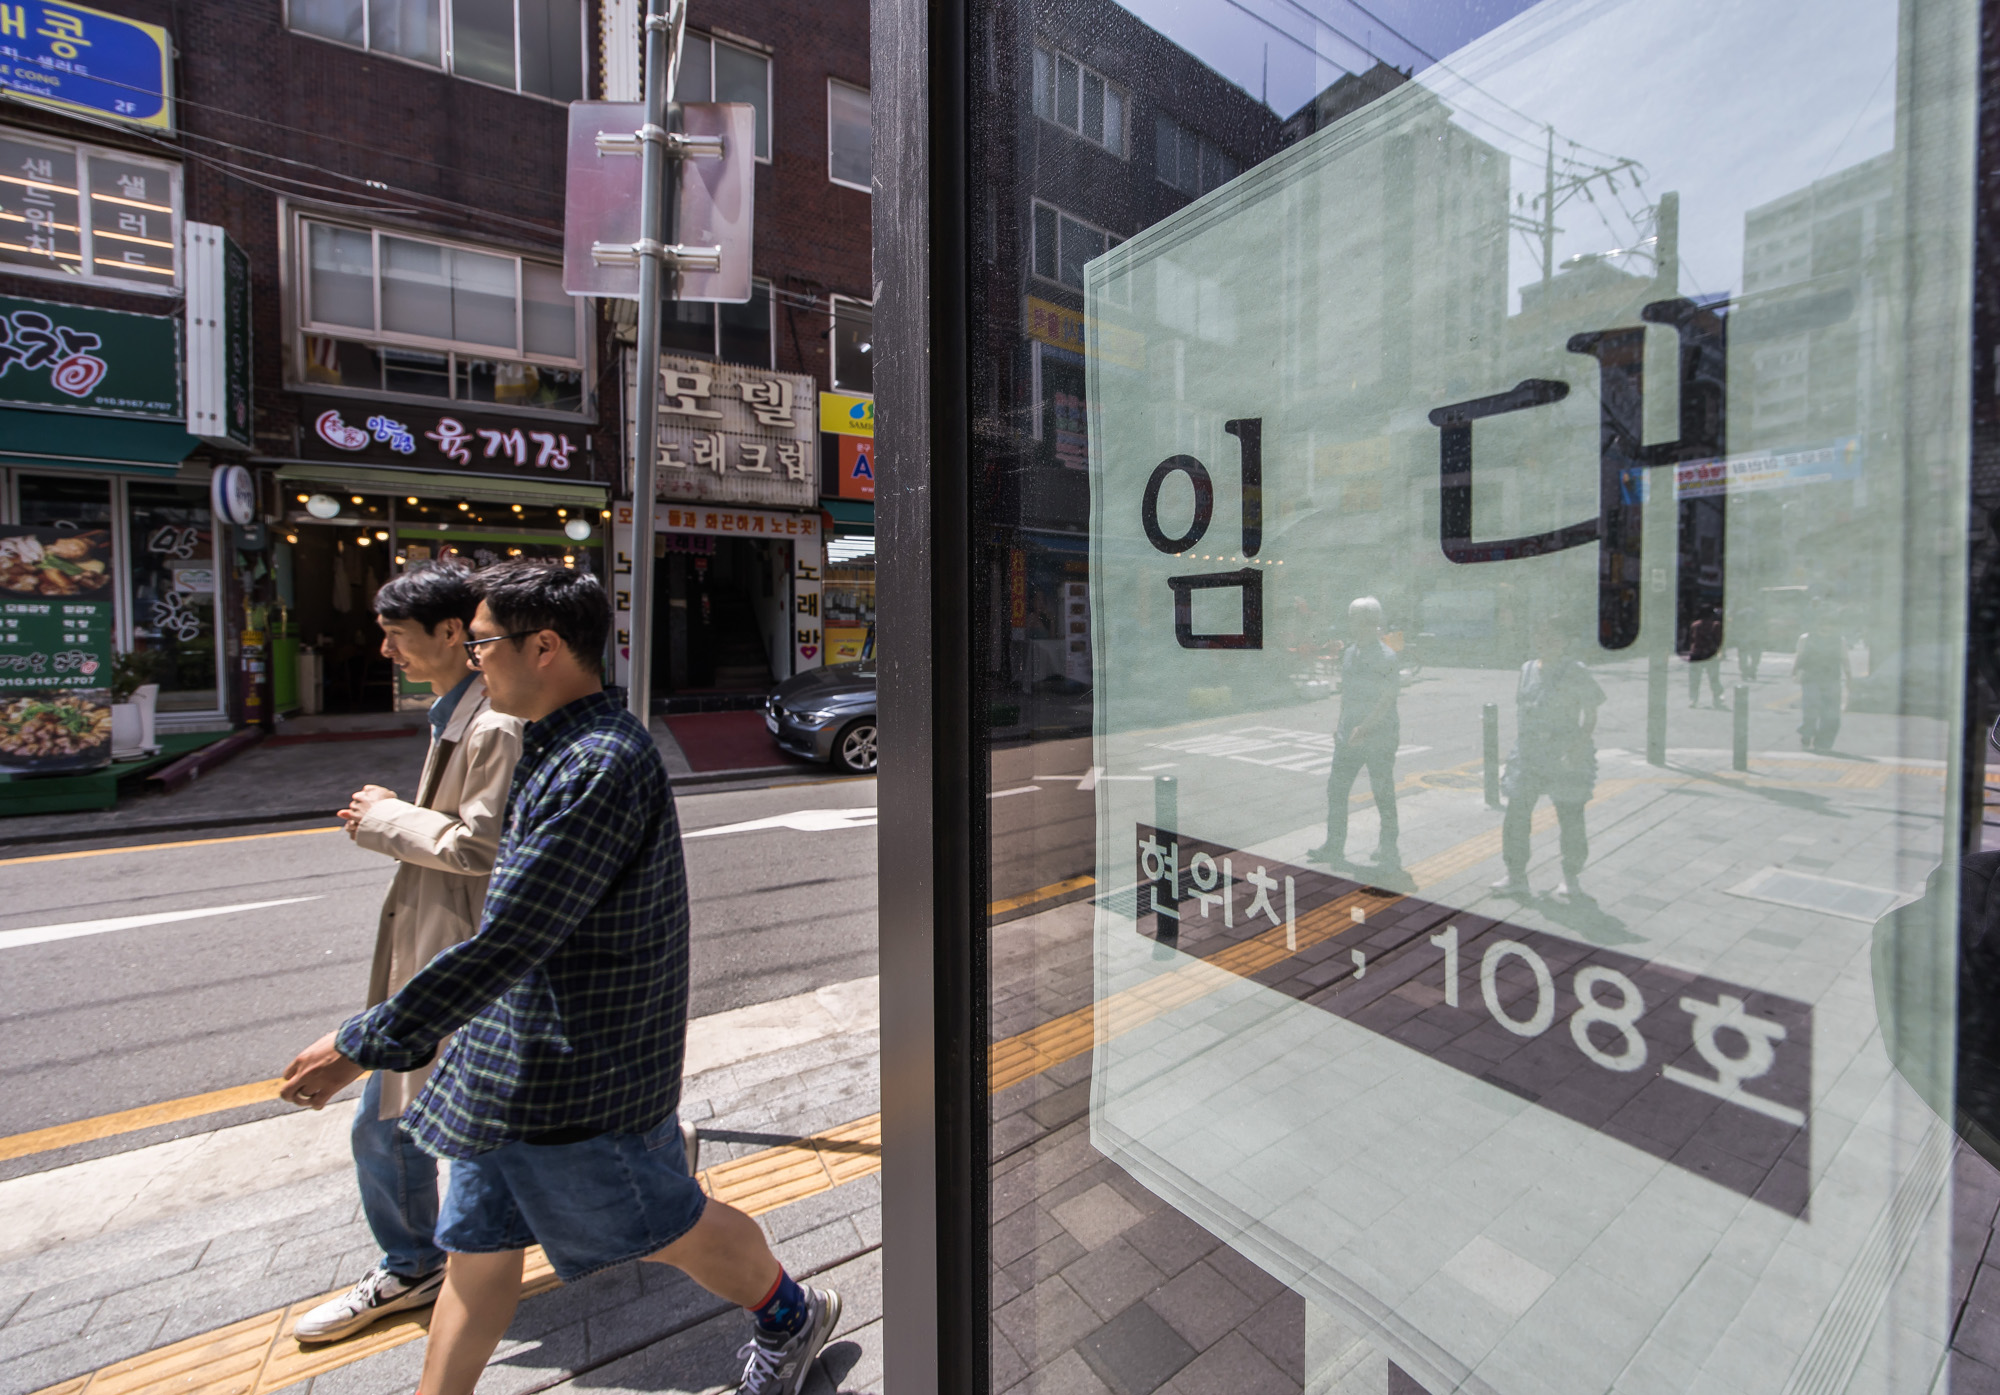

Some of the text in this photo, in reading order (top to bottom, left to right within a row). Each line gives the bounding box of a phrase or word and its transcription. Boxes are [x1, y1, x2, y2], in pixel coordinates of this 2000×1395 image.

[114, 99, 136, 113] 2F
[117, 173, 147, 268] 샐러드
[425, 417, 578, 471] 육개장
[705, 512, 765, 533] 화끈하게
[1138, 834, 1297, 952] 현위치
[1430, 924, 1806, 1129] 108호
